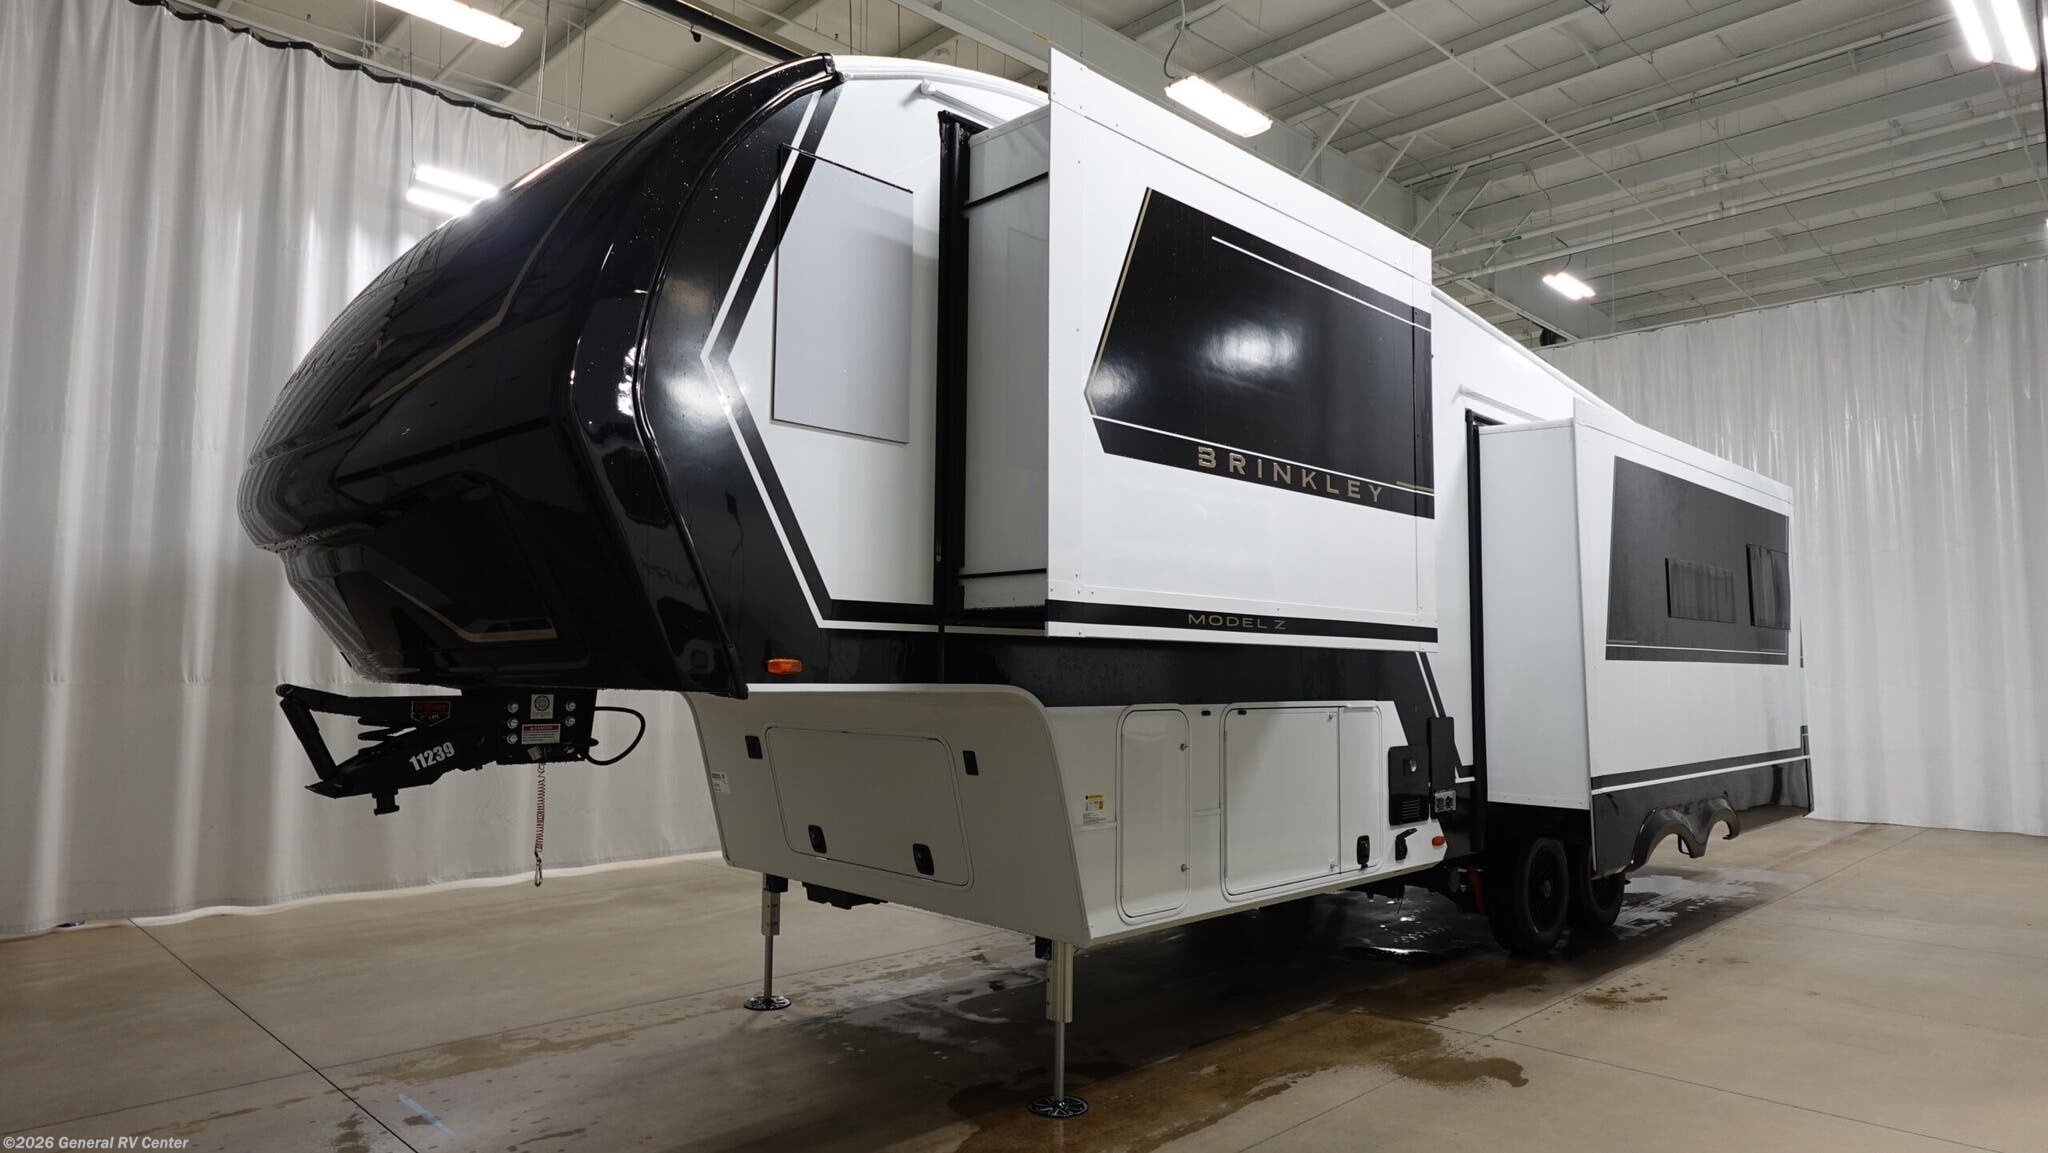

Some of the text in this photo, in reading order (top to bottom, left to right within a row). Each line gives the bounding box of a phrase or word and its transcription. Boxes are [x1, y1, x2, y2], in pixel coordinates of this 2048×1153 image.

[1198, 446, 1383, 502] BRINKLEY
[1188, 613, 1287, 630] MODEL Z
[409, 741, 455, 771] 11239
